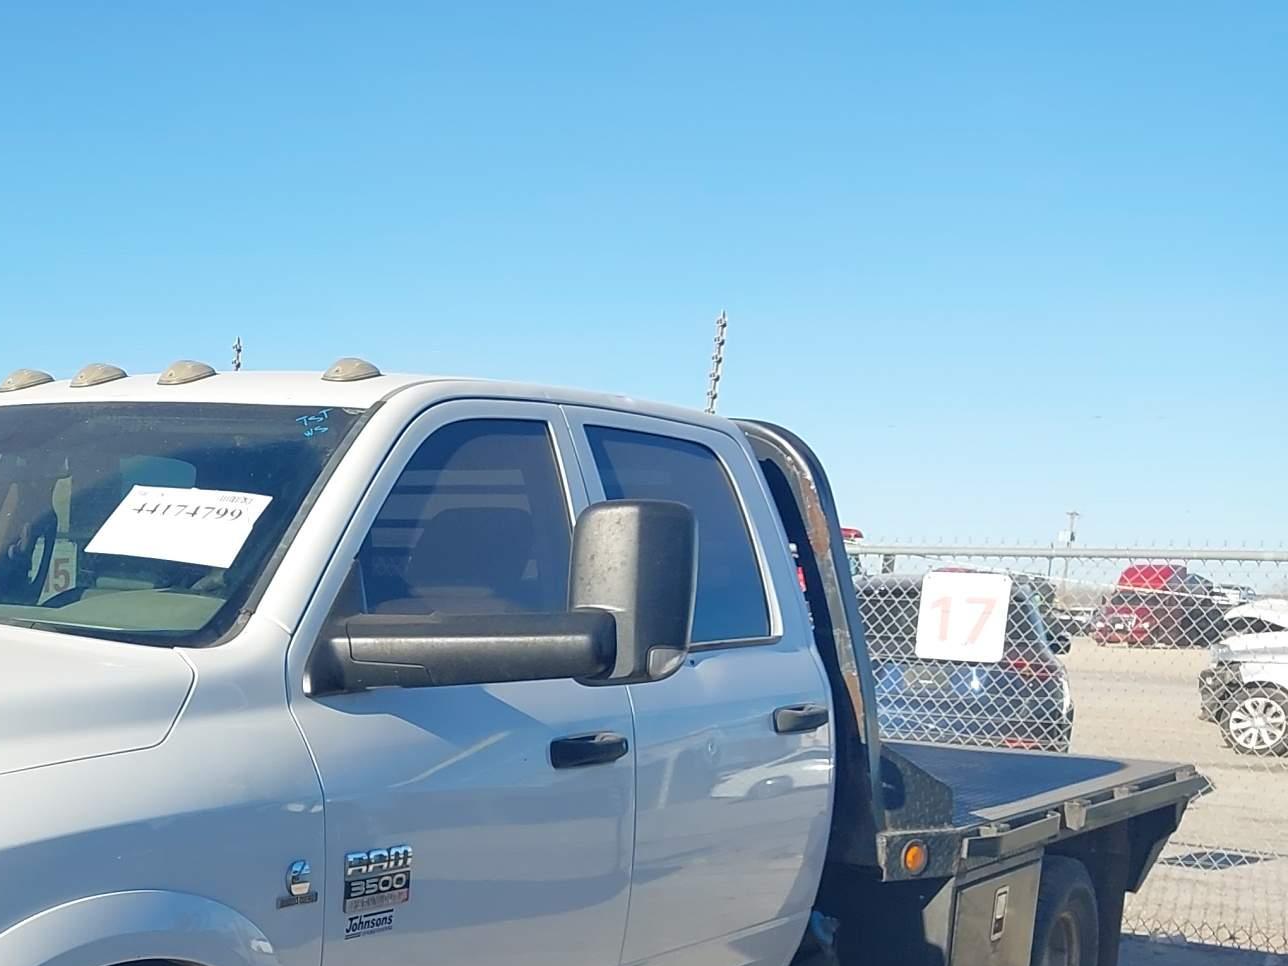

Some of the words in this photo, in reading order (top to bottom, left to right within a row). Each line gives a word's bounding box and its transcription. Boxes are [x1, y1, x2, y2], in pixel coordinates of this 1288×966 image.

[132, 502, 243, 520] 44174799
[931, 596, 997, 645] 17
[346, 844, 412, 876] RAM
[350, 873, 407, 898] 3500
[345, 914, 393, 934] Johnsons
